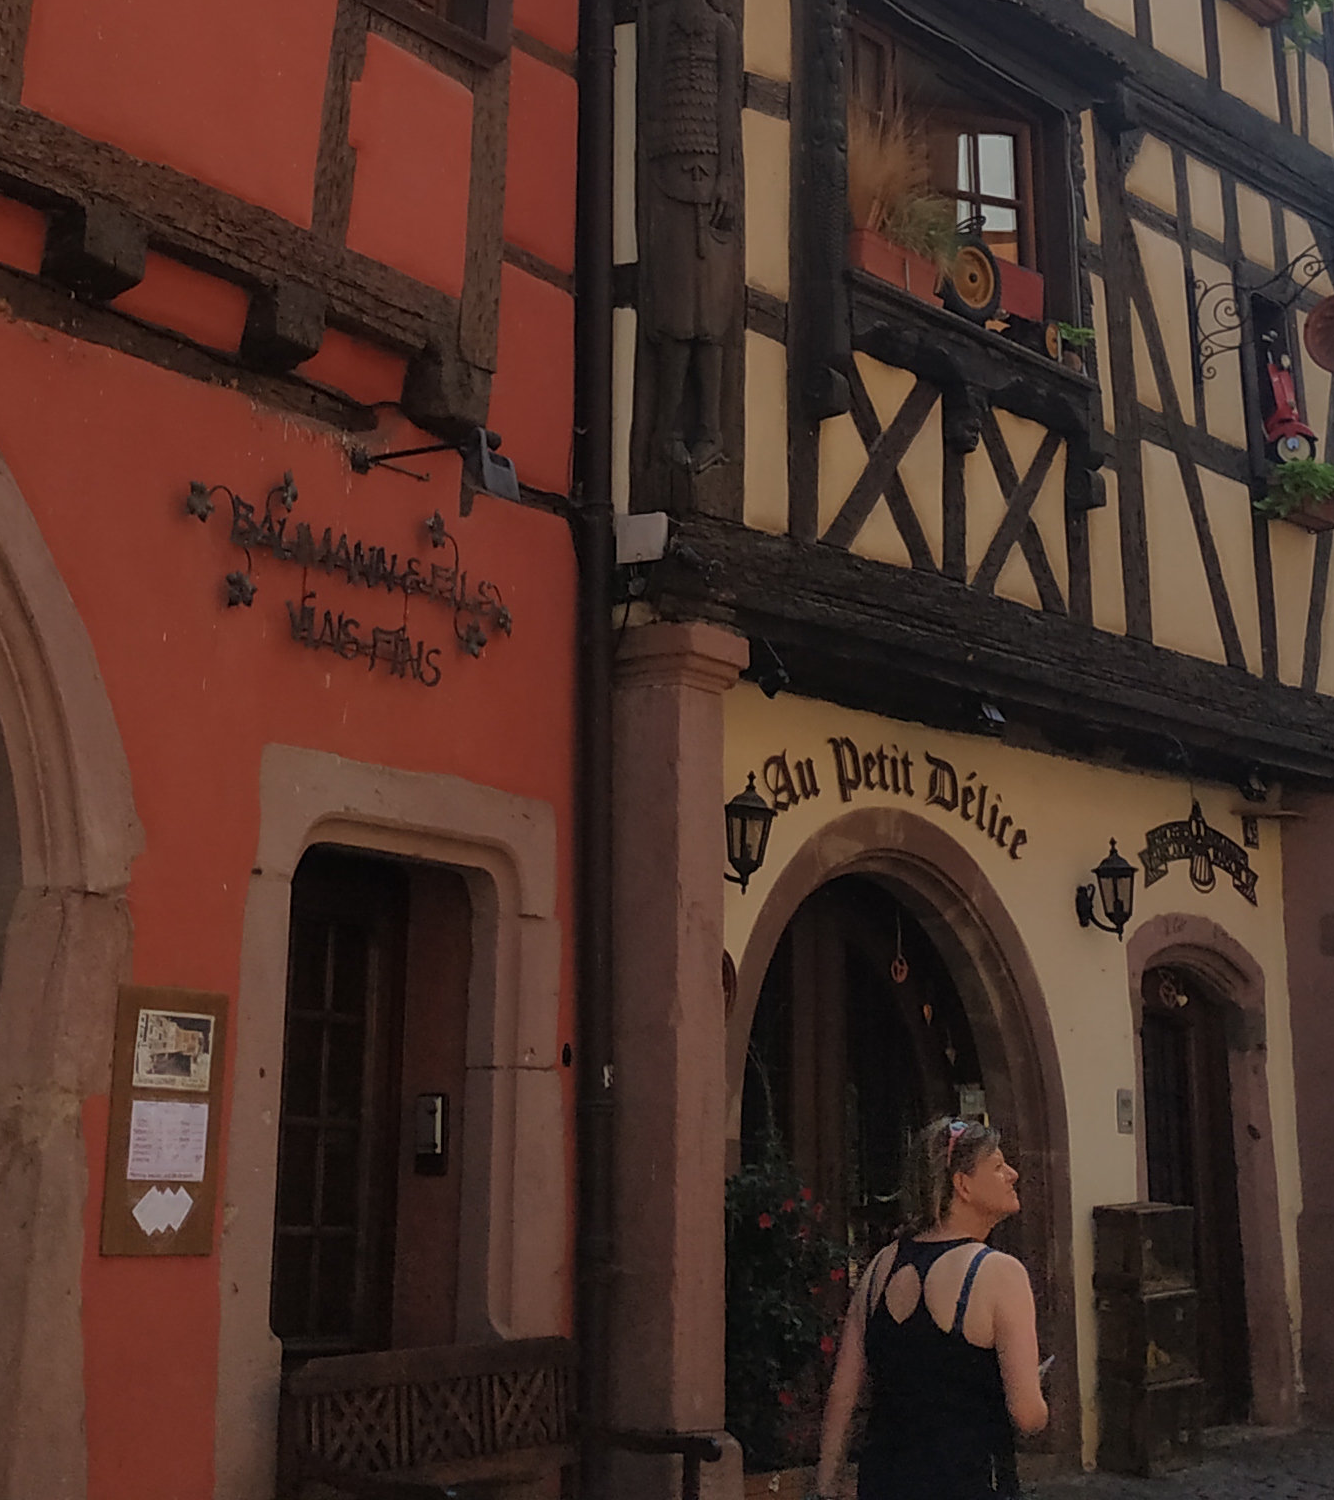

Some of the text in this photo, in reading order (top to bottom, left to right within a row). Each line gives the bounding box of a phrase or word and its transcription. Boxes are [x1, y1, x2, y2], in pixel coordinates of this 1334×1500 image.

[763, 735, 1028, 860] Au Petit Délice
